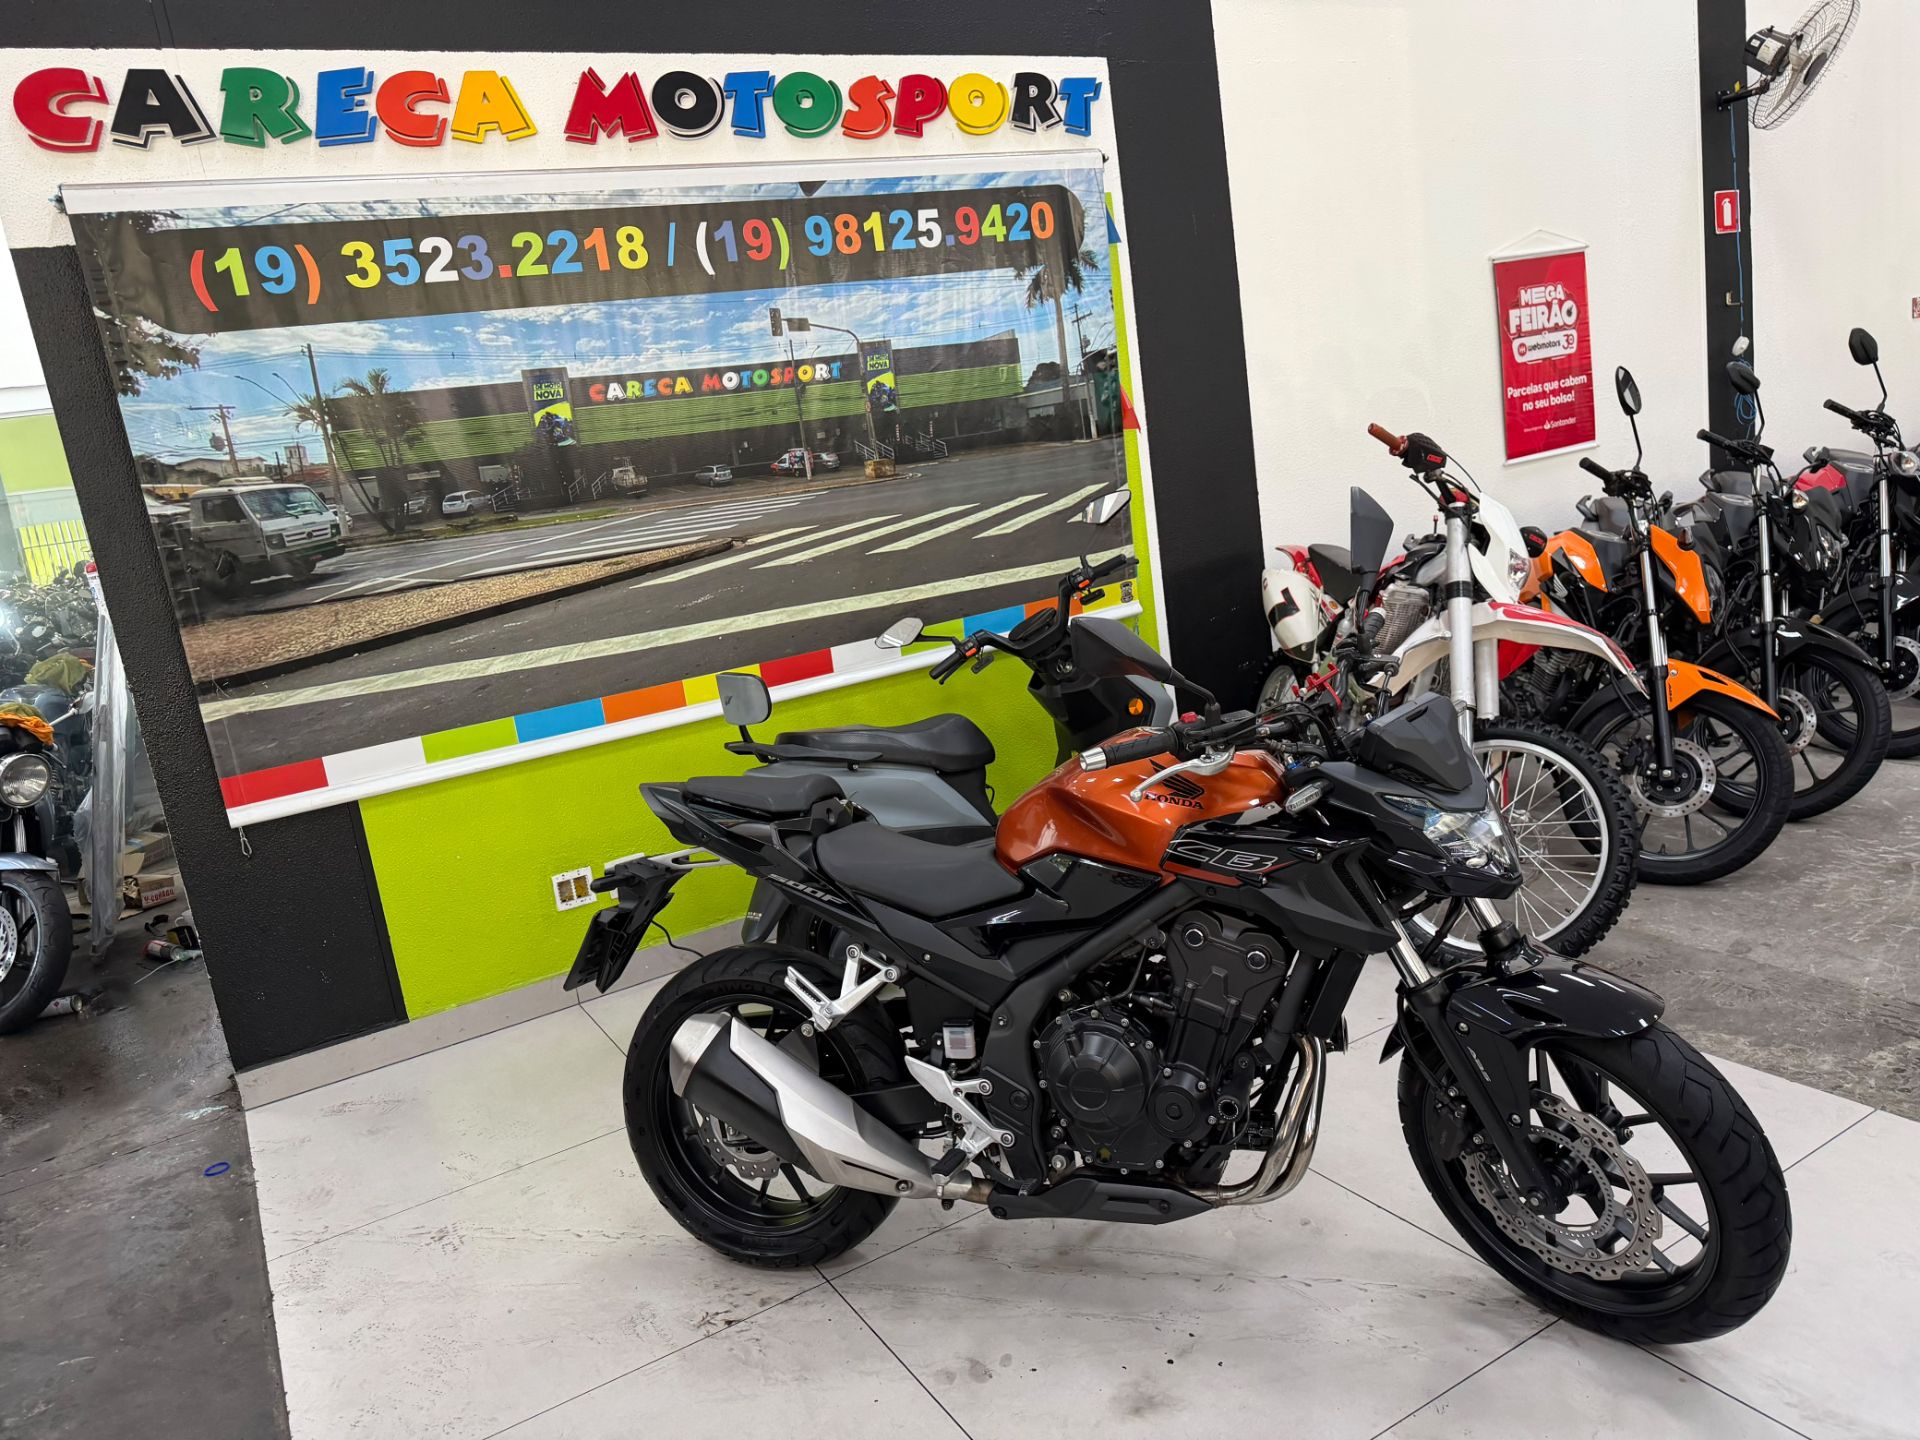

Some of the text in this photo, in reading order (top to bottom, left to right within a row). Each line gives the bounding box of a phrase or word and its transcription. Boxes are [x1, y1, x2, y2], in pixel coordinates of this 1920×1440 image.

[13, 66, 1100, 153] CARECA MOTOSPORT
[190, 202, 1054, 312] (19) 3523.2218 / (19) 98125.9420
[1520, 284, 1565, 306] MEGA
[1508, 299, 1577, 334] FEIRÃO
[1527, 334, 1575, 352] webmotors 30
[868, 361, 888, 370] NOVA
[589, 361, 841, 402] CARECA MOTOSPORT
[1507, 374, 1587, 399] Parcelas que cabem
[535, 390, 562, 400] NOVA
[1522, 391, 1575, 411] no seu bolso!
[1550, 416, 1577, 428] Santander
[1145, 793, 1204, 810] HONDA
[1166, 839, 1278, 872] CB
[768, 873, 848, 905] 500F
